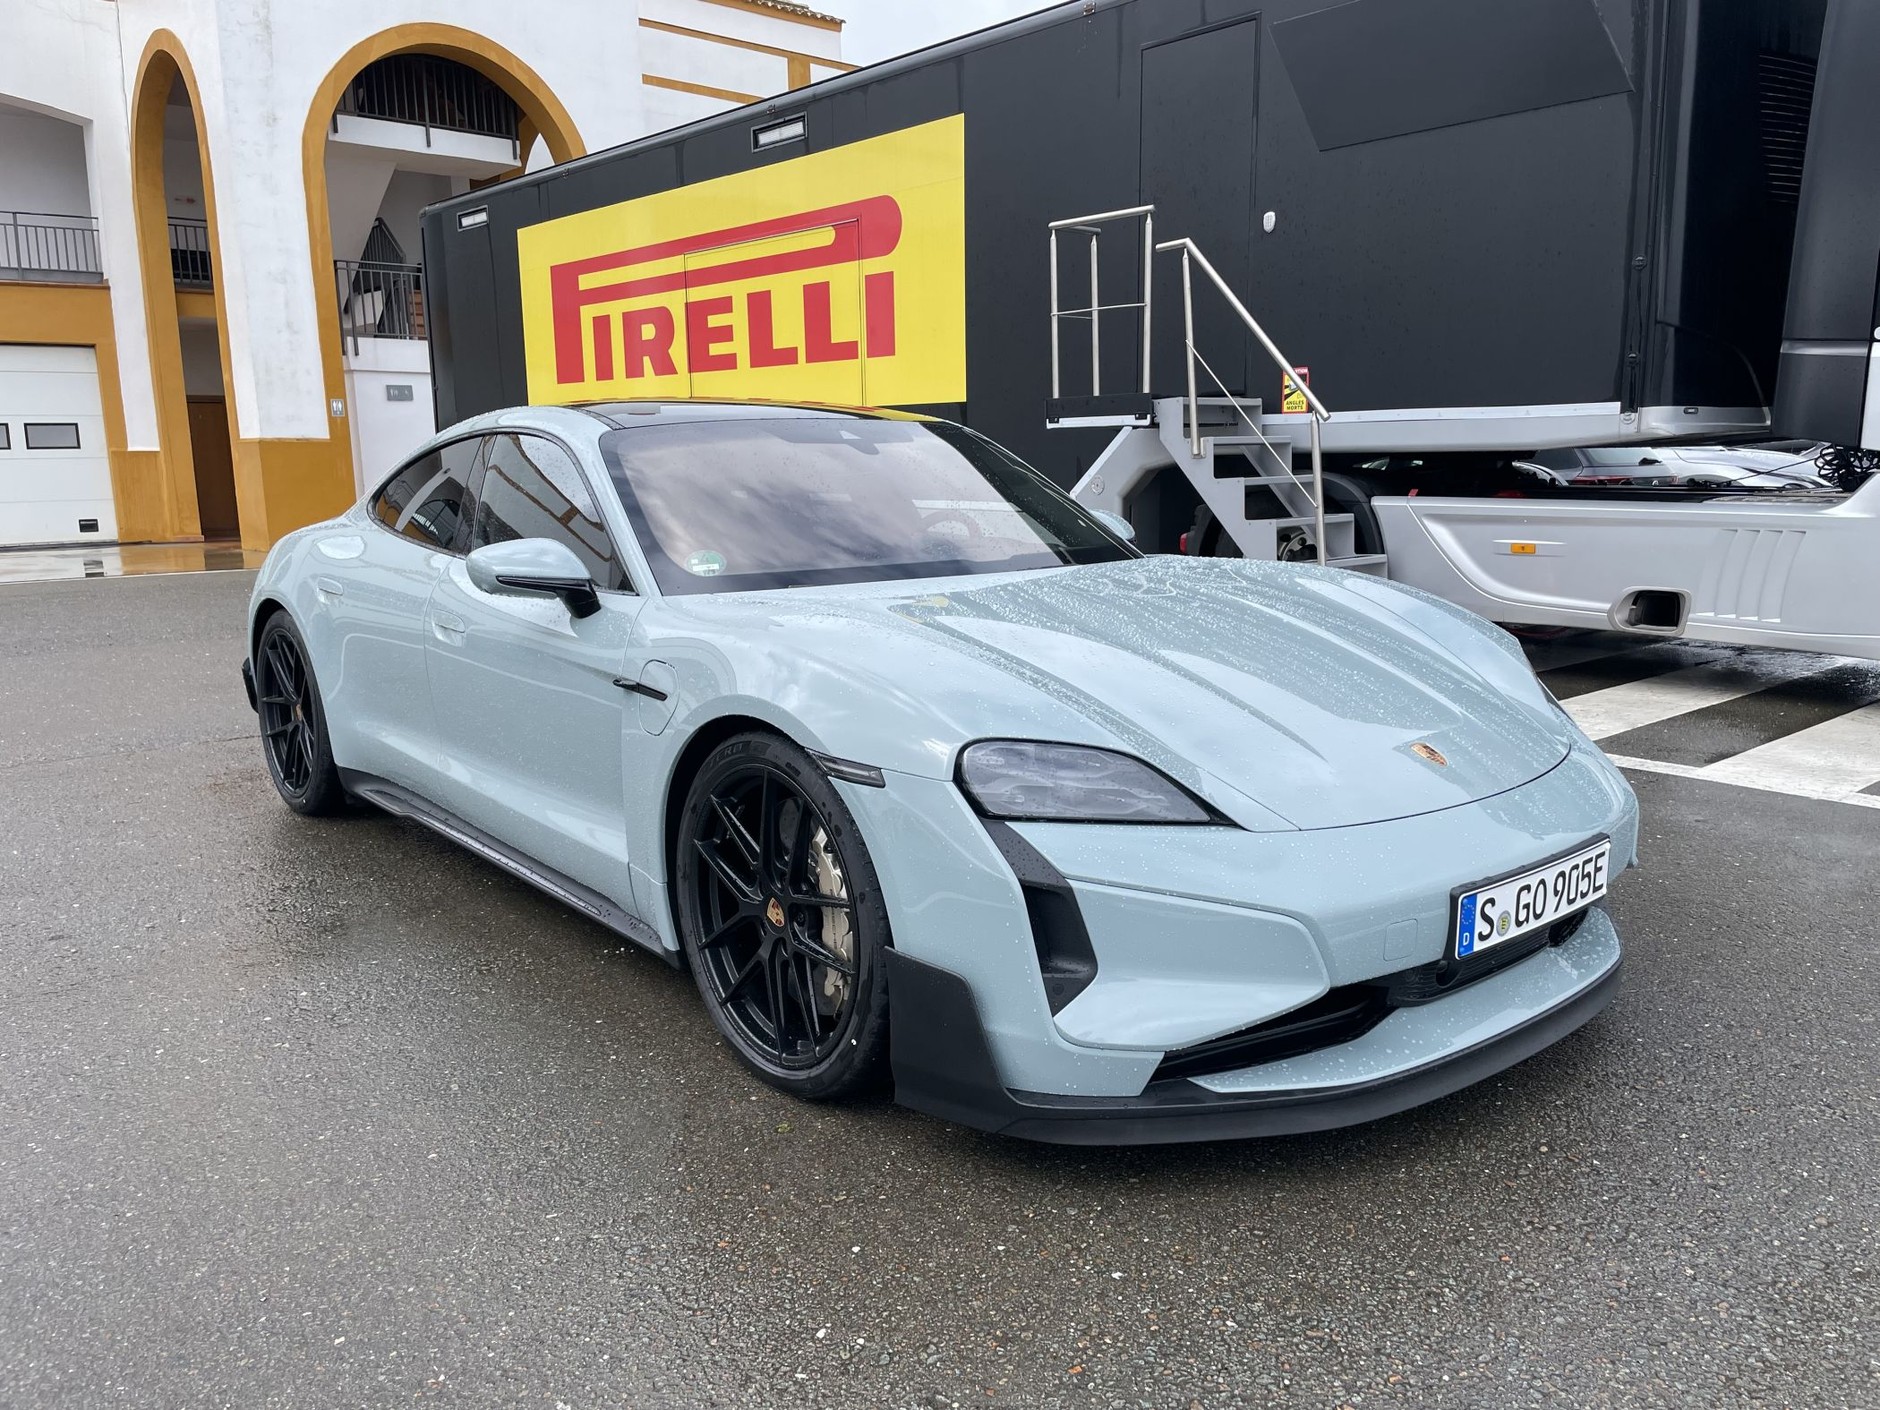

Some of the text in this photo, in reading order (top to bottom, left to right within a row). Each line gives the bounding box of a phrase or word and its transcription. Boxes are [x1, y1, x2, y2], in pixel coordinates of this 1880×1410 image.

[550, 195, 903, 384] PIRELLI
[1462, 932, 1469, 946] D
[1477, 851, 1606, 942] S GO 905E
